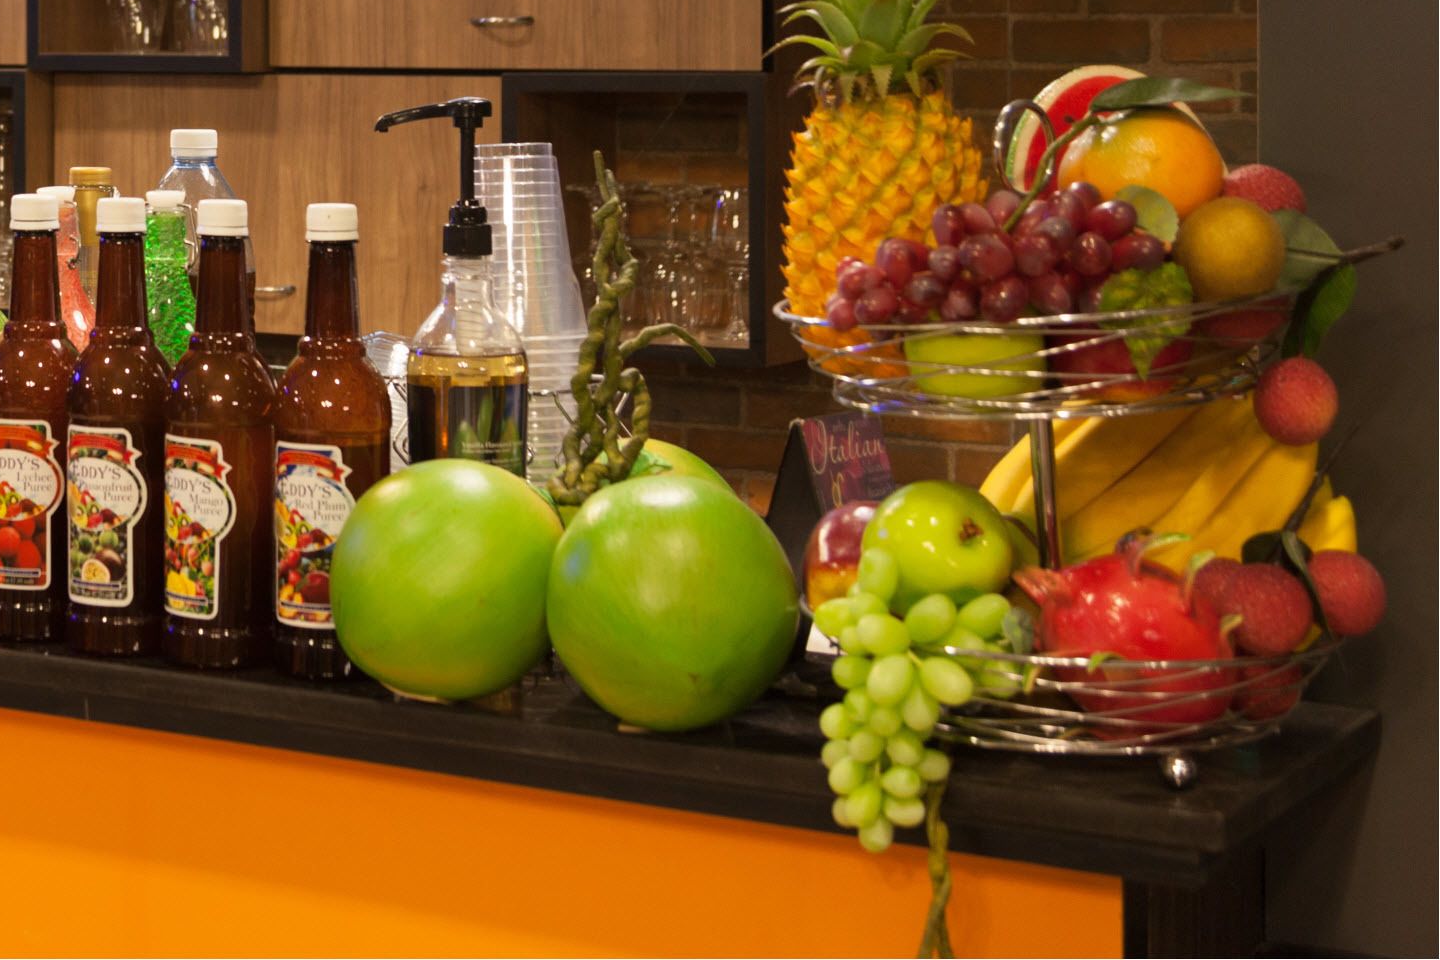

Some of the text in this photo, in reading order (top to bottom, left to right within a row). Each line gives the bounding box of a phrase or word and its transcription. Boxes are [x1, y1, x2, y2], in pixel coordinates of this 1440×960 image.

[17, 471, 52, 483] Lychee
[72, 463, 122, 479] EDDY'S
[281, 482, 331, 499] EDDY'S
[189, 494, 224, 507] Mango
[317, 501, 346, 512] Plum
